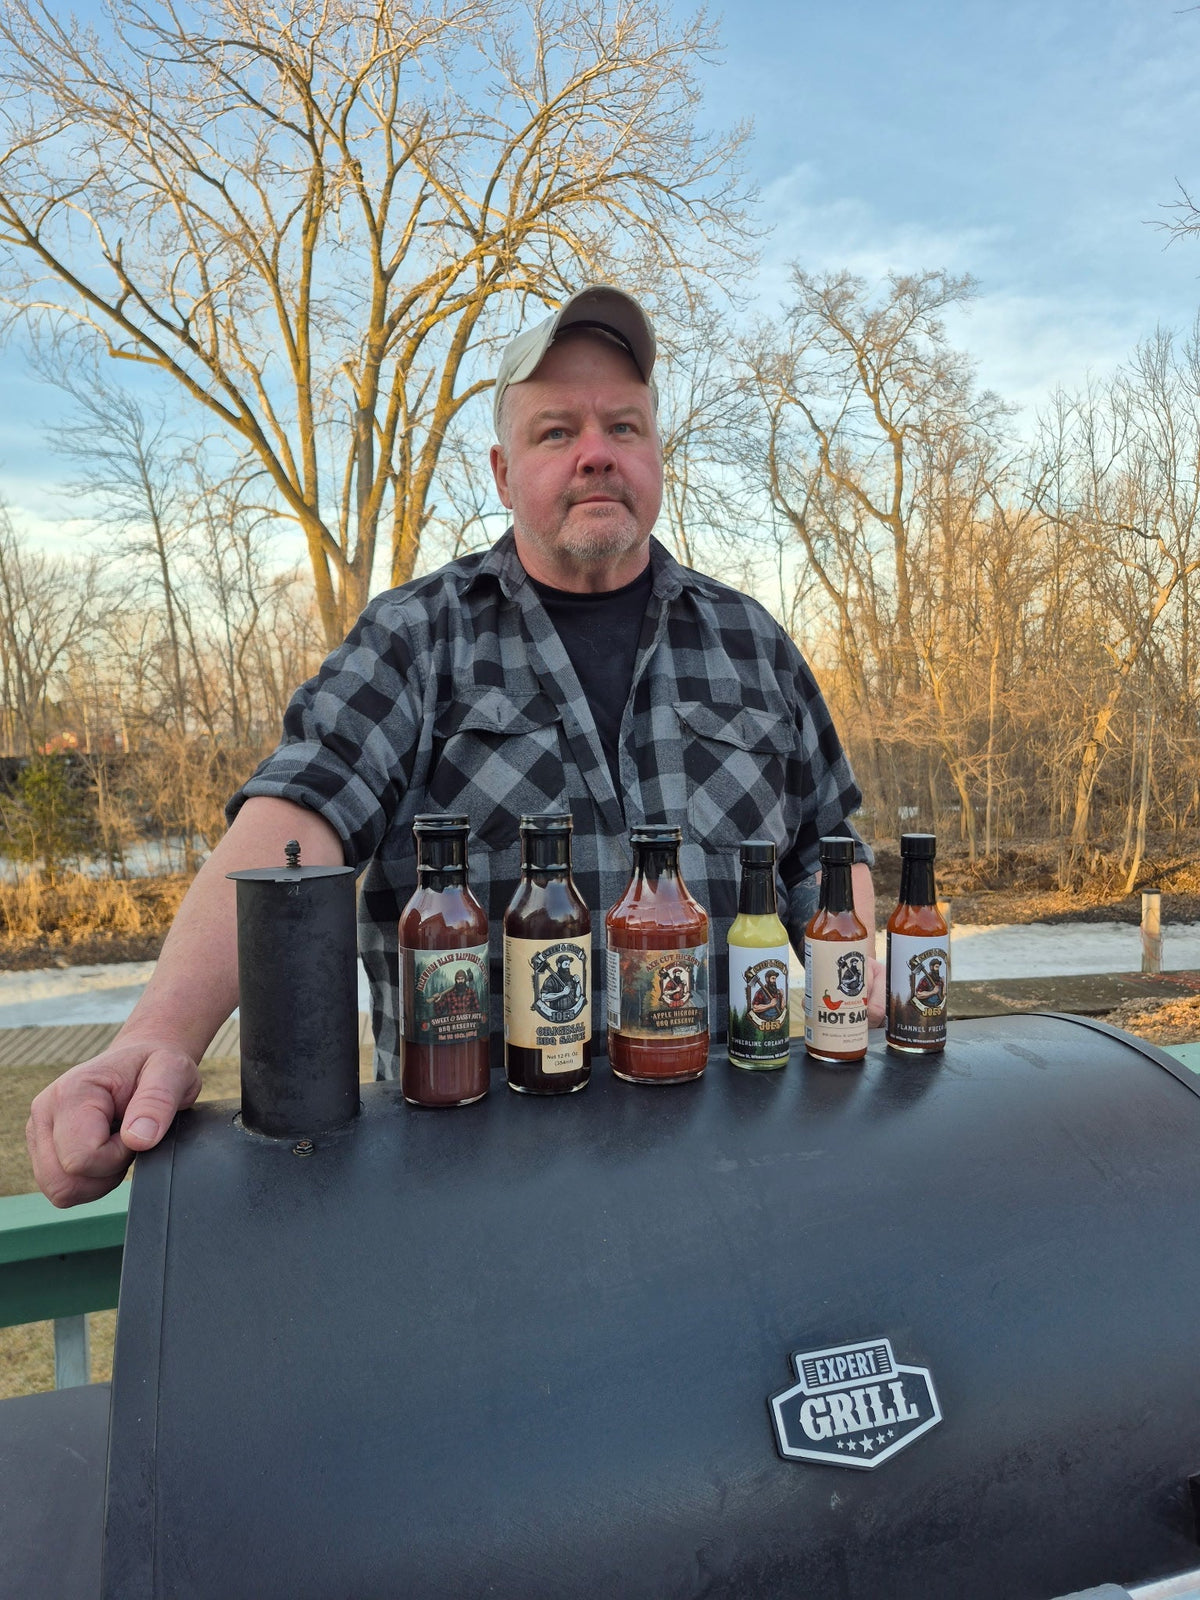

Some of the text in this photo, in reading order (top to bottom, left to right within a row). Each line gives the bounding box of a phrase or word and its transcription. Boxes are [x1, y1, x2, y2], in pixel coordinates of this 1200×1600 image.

[659, 954, 674, 964] CUT
[431, 1016, 449, 1026] SWEET
[653, 1011, 672, 1020] APPLE
[818, 1011, 845, 1024] HOT
[536, 1022, 585, 1036] ORIGINAL
[656, 1019, 669, 1028] BBQ
[896, 1023, 926, 1033] FLANNEL
[536, 1032, 585, 1045] BBQ SAUCE
[814, 1350, 877, 1385] EXPERT
[799, 1381, 920, 1442] GRILL
